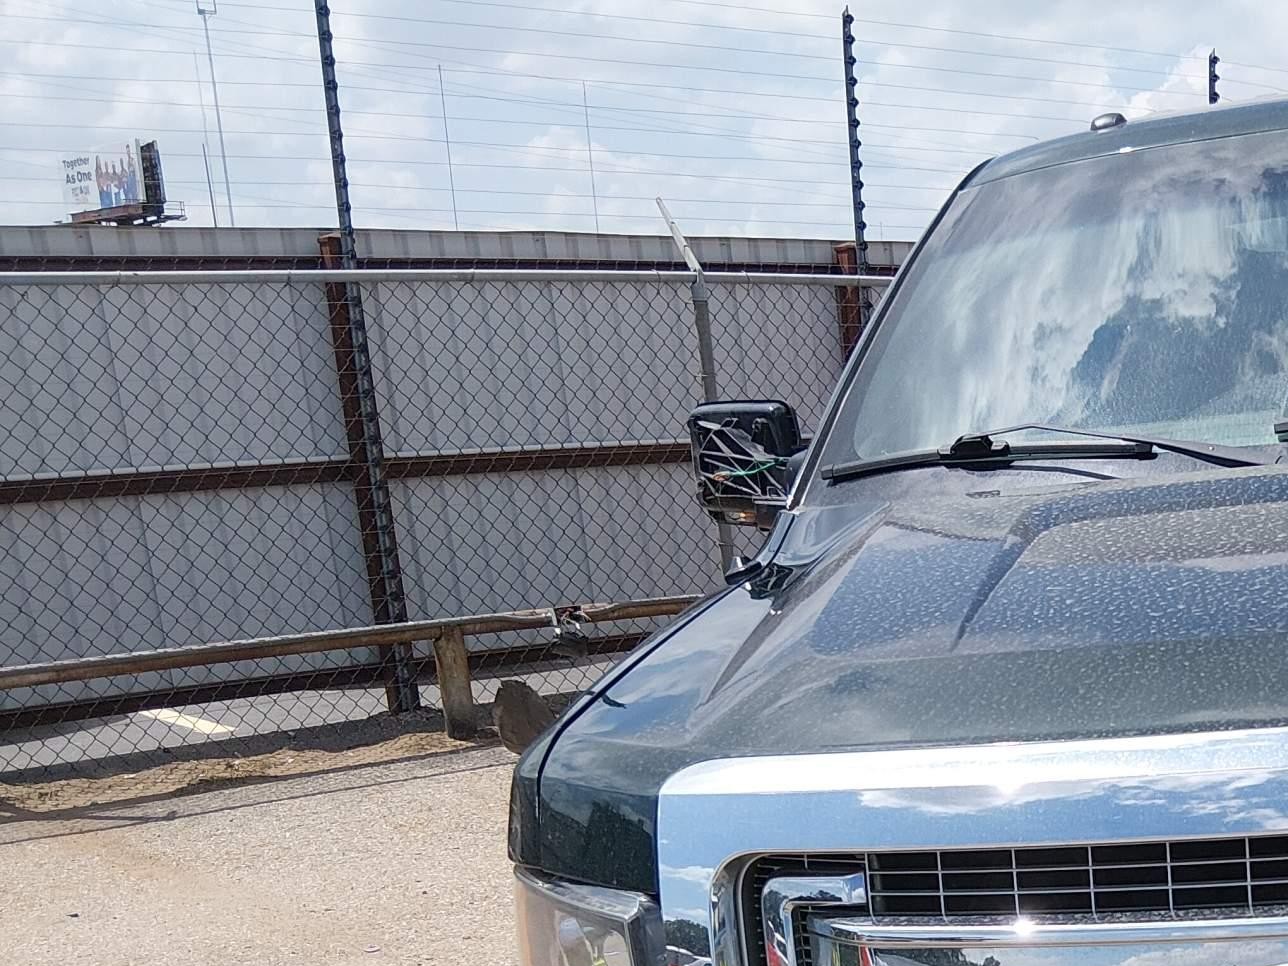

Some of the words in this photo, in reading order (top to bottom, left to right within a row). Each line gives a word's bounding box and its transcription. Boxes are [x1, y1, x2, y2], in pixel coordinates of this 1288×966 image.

[62, 156, 90, 170] Together
[66, 173, 76, 184] As
[77, 171, 92, 182] One
